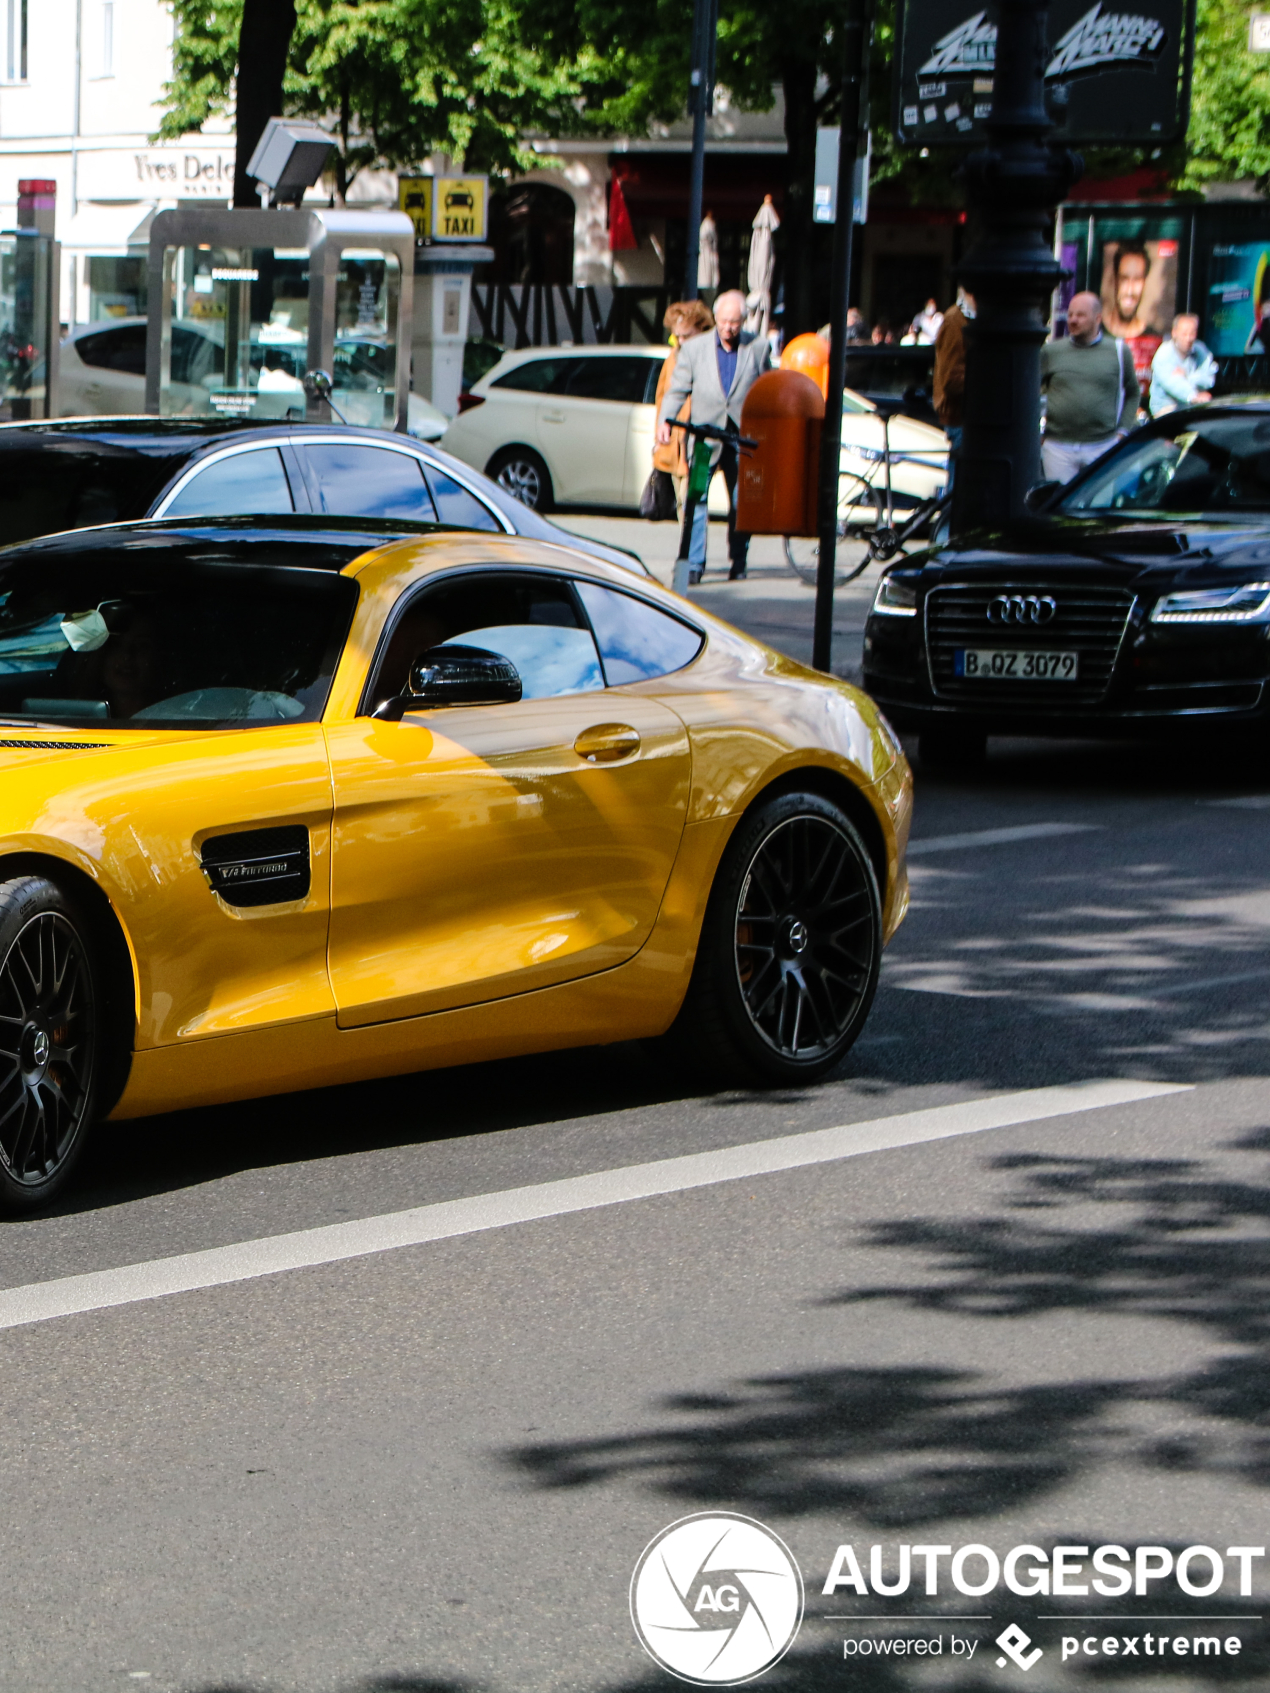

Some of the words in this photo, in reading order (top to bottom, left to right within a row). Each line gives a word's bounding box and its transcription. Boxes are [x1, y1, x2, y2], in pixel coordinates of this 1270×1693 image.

[134, 154, 177, 181] Yves
[444, 217, 474, 236] TAXI
[966, 652, 979, 674] B
[991, 653, 1018, 676] QZ
[1022, 654, 1075, 678] 3079
